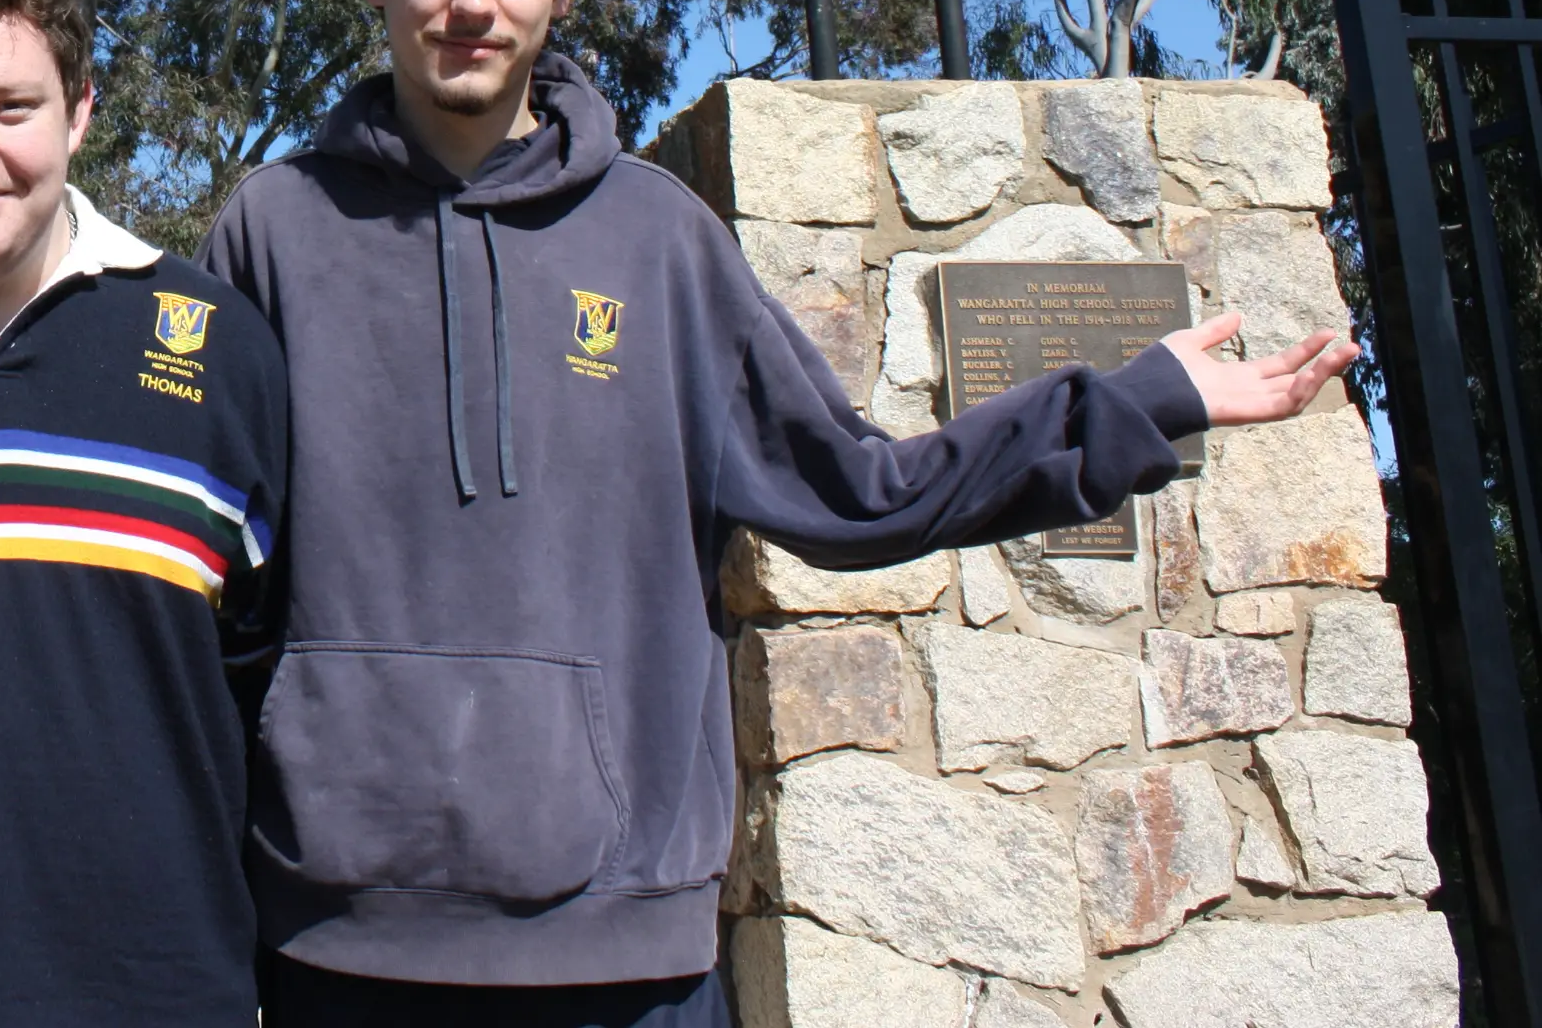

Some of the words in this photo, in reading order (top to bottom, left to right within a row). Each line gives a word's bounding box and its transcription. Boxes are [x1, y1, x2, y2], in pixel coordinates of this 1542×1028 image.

[1026, 283, 1039, 294] IN
[1043, 283, 1107, 294] MEMORIAM
[957, 297, 1036, 309] WANGARATTA
[1040, 298, 1070, 310] HIGH
[1074, 299, 1117, 310] SCHOOL
[1120, 299, 1176, 310] STUDENTS
[976, 314, 1004, 325] WHO
[1009, 314, 1035, 325] FELL
[1040, 314, 1052, 325] IN
[1056, 314, 1080, 325] THE
[1135, 314, 1161, 325] WAR
[144, 349, 204, 373] WANGARATTA
[168, 366, 195, 379] SCHOOL
[138, 373, 204, 404] THOMAS
[1082, 524, 1125, 535] WEBSTER
[1062, 537, 1079, 545] LEST
[1080, 537, 1092, 545] WE
[1094, 537, 1123, 545] FORGET
